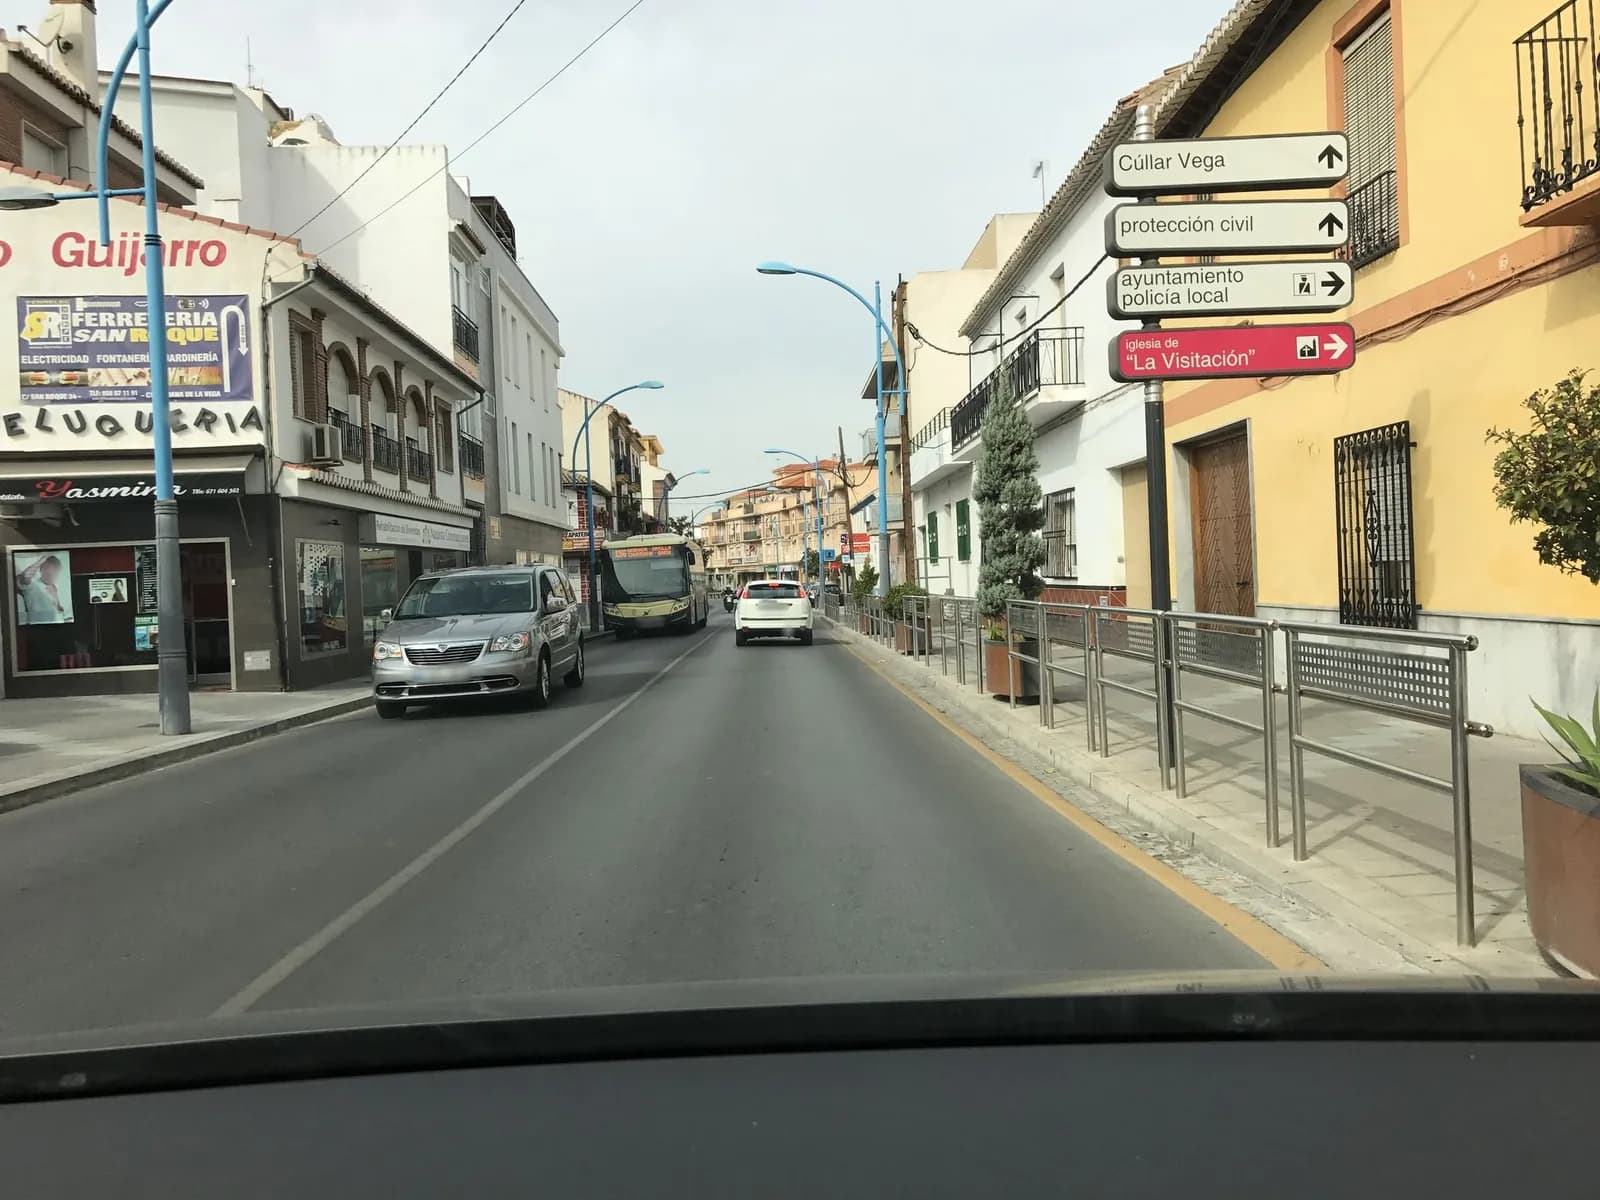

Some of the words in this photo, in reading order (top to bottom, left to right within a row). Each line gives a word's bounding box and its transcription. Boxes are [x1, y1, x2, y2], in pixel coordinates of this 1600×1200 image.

[1118, 153, 1172, 172] Cúllar
[1177, 152, 1226, 172] Vega
[1120, 216, 1215, 237] protección
[1220, 215, 1254, 232] civil
[52, 231, 227, 276] Guijrro
[1121, 268, 1244, 290] ayuntamiento
[1122, 290, 1181, 310] policía
[1187, 287, 1229, 305] local
[72, 310, 218, 328] FERREERIA
[72, 328, 127, 342] SAN
[129, 327, 219, 346] RQUE
[1125, 338, 1161, 352] iglesia
[1164, 337, 1179, 348] de
[21, 355, 89, 364] ELECTRICIDAD
[97, 351, 149, 363] FONTANERÍ
